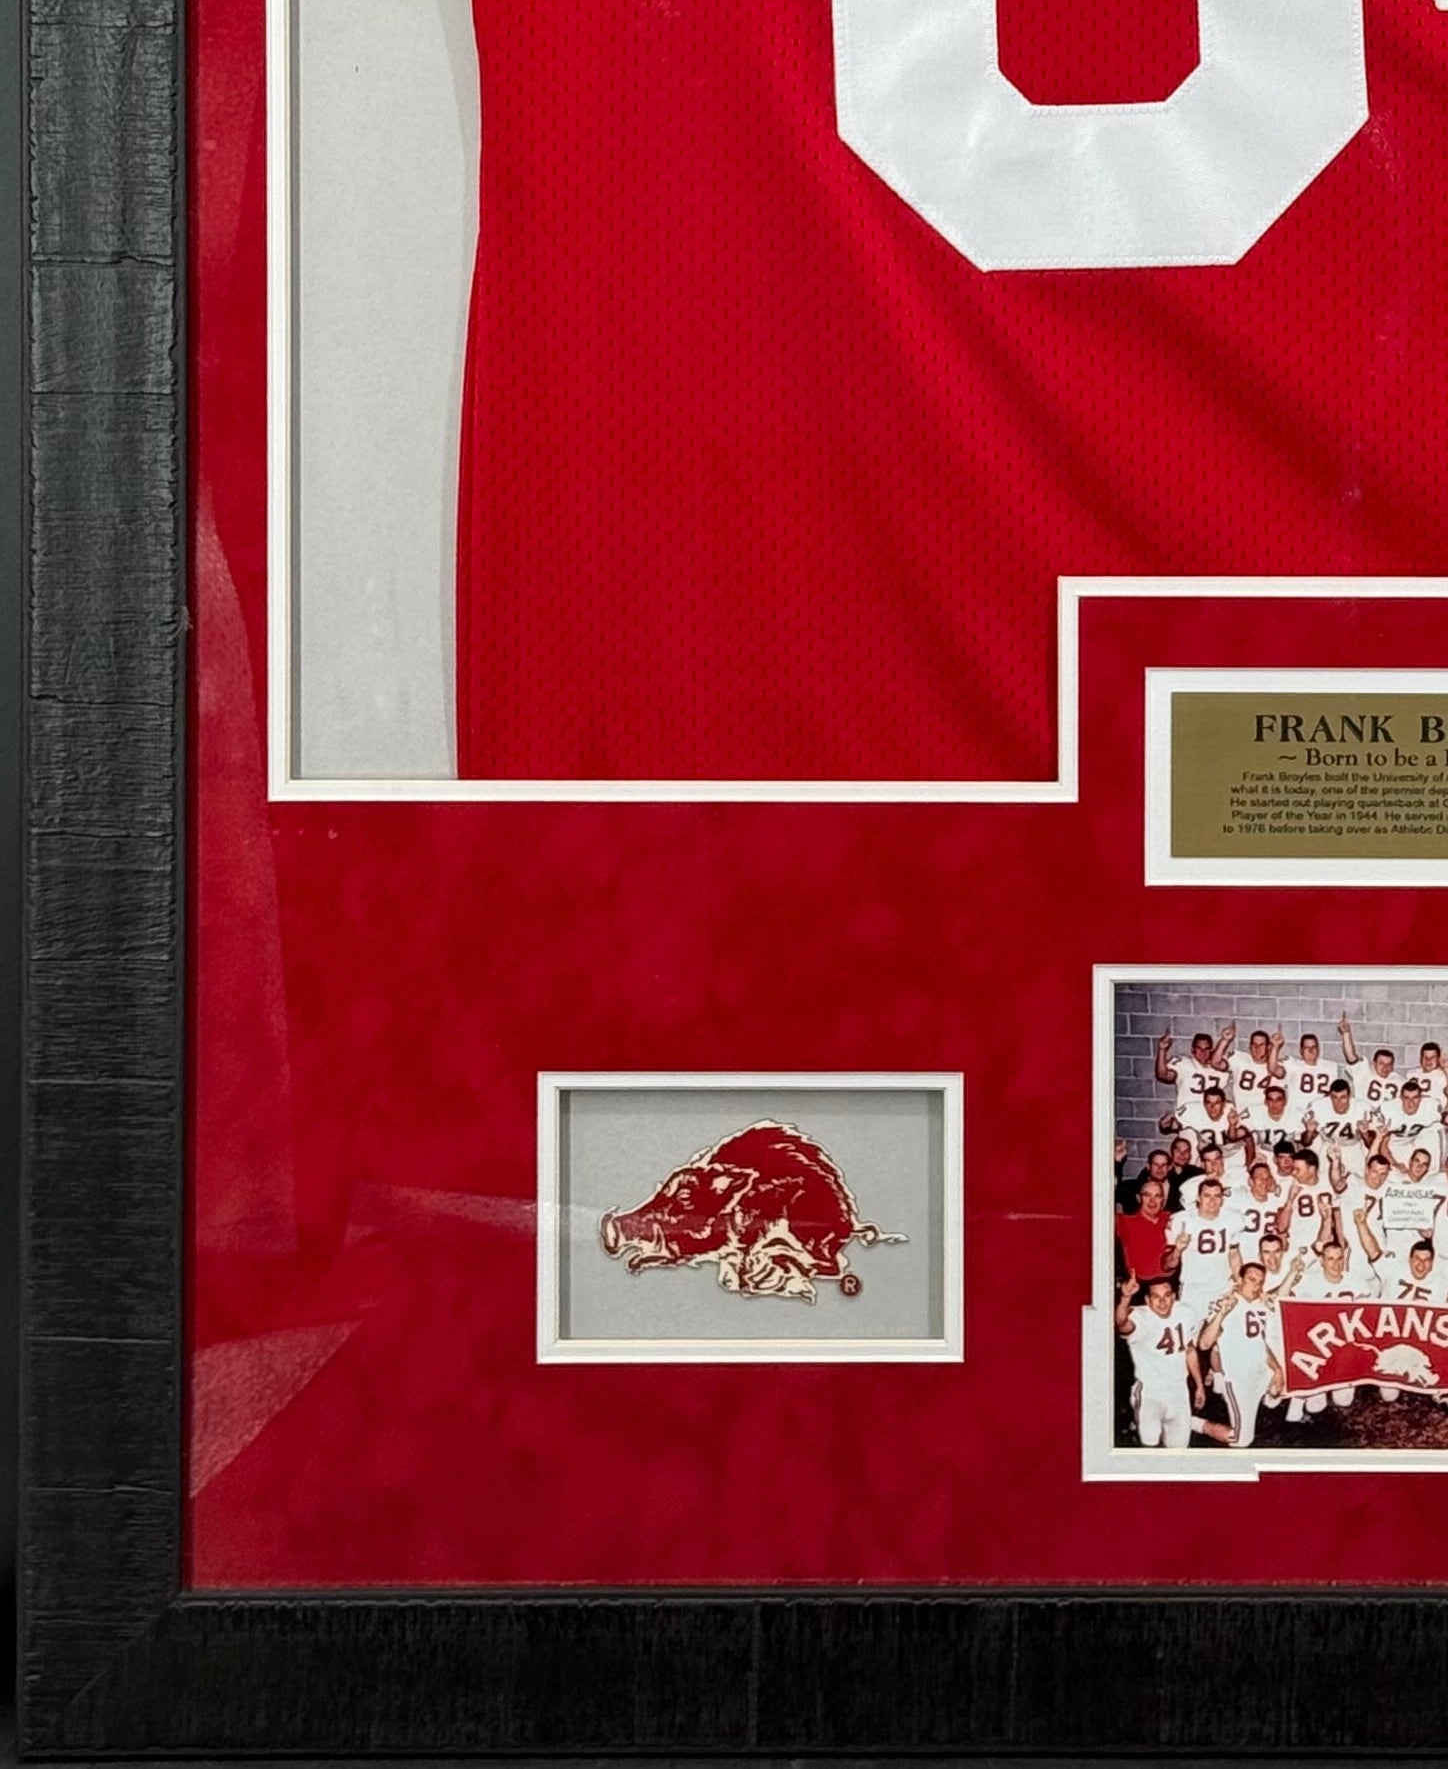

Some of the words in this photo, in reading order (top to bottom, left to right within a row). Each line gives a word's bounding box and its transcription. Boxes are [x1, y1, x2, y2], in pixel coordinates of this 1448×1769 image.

[1253, 714, 1395, 742] FRANK
[1304, 747, 1359, 765] Born
[1365, 747, 1388, 765] to
[1393, 748, 1420, 766] be
[1425, 752, 1438, 766] a
[1242, 770, 1276, 781] Frank
[1278, 770, 1323, 783] Broyles
[1323, 770, 1350, 781] built
[1351, 770, 1371, 781] the
[1372, 771, 1430, 784] University
[1230, 782, 1259, 793] what
[1320, 786, 1344, 794] one
[1359, 783, 1380, 794] the
[1381, 784, 1427, 797] premier
[1249, 796, 1291, 807] started
[1291, 796, 1312, 807] out
[1312, 796, 1355, 810] playing
[1356, 797, 1426, 810] quarterback
[1231, 809, 1269, 822] Player
[1285, 809, 1305, 820] the
[1306, 809, 1334, 820] Year
[1404, 810, 1444, 821] served
[1268, 822, 1305, 833] before
[1307, 822, 1344, 836] taking
[1345, 825, 1372, 833] over
[1390, 823, 1434, 834] Athletic
[1239, 1070, 1272, 1091] 84
[1299, 1073, 1332, 1094] 82
[1367, 1079, 1398, 1101] 63
[1325, 1121, 1355, 1140] 74
[1243, 1208, 1278, 1234] 32
[1198, 1228, 1227, 1255] 61
[1156, 1322, 1186, 1355] 41
